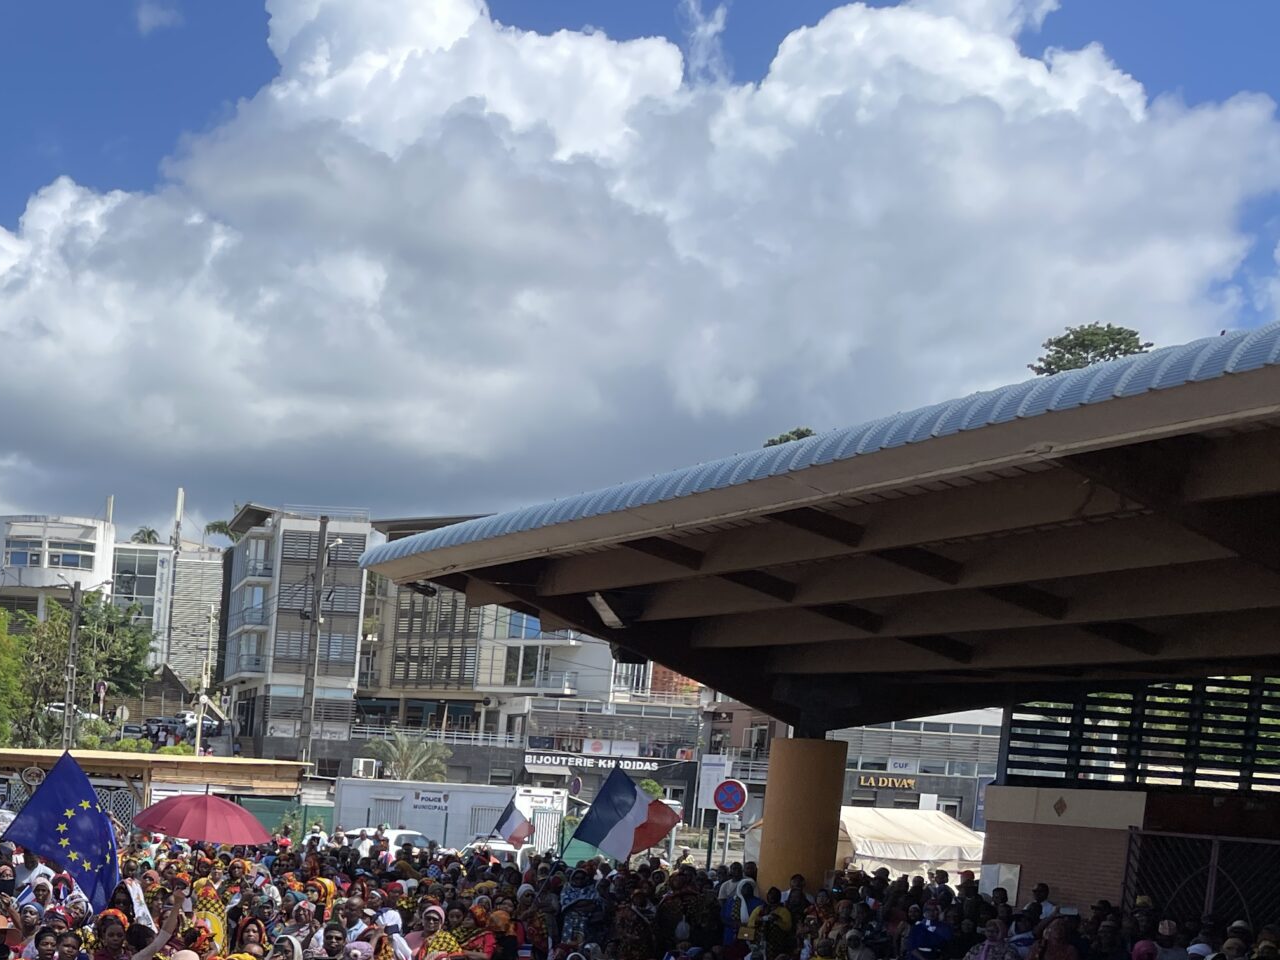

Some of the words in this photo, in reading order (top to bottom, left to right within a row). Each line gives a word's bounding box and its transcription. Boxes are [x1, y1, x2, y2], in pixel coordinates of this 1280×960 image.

[524, 754, 595, 767] BIJOUTERIE
[860, 776, 875, 787] LA
[879, 777, 909, 789] DIVA
